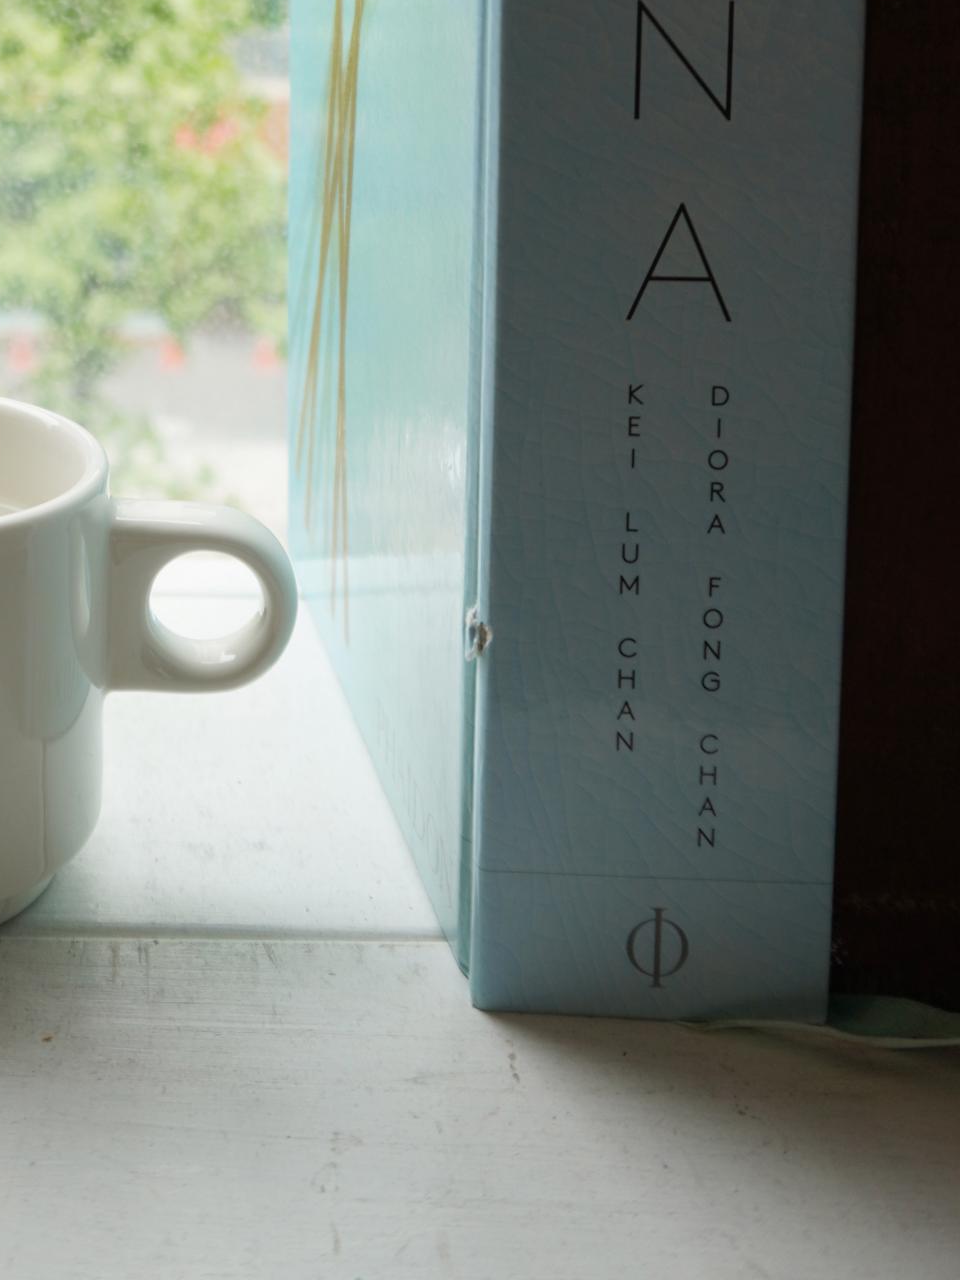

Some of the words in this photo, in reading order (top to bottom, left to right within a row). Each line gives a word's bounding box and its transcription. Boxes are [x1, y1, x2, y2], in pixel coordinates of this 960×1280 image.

[627, 383, 645, 470] KEI
[706, 384, 730, 535] DIORA
[619, 511, 640, 595] LUM
[700, 576, 724, 692] FONG
[616, 637, 638, 752] CHAN
[696, 734, 719, 848] CHAN
